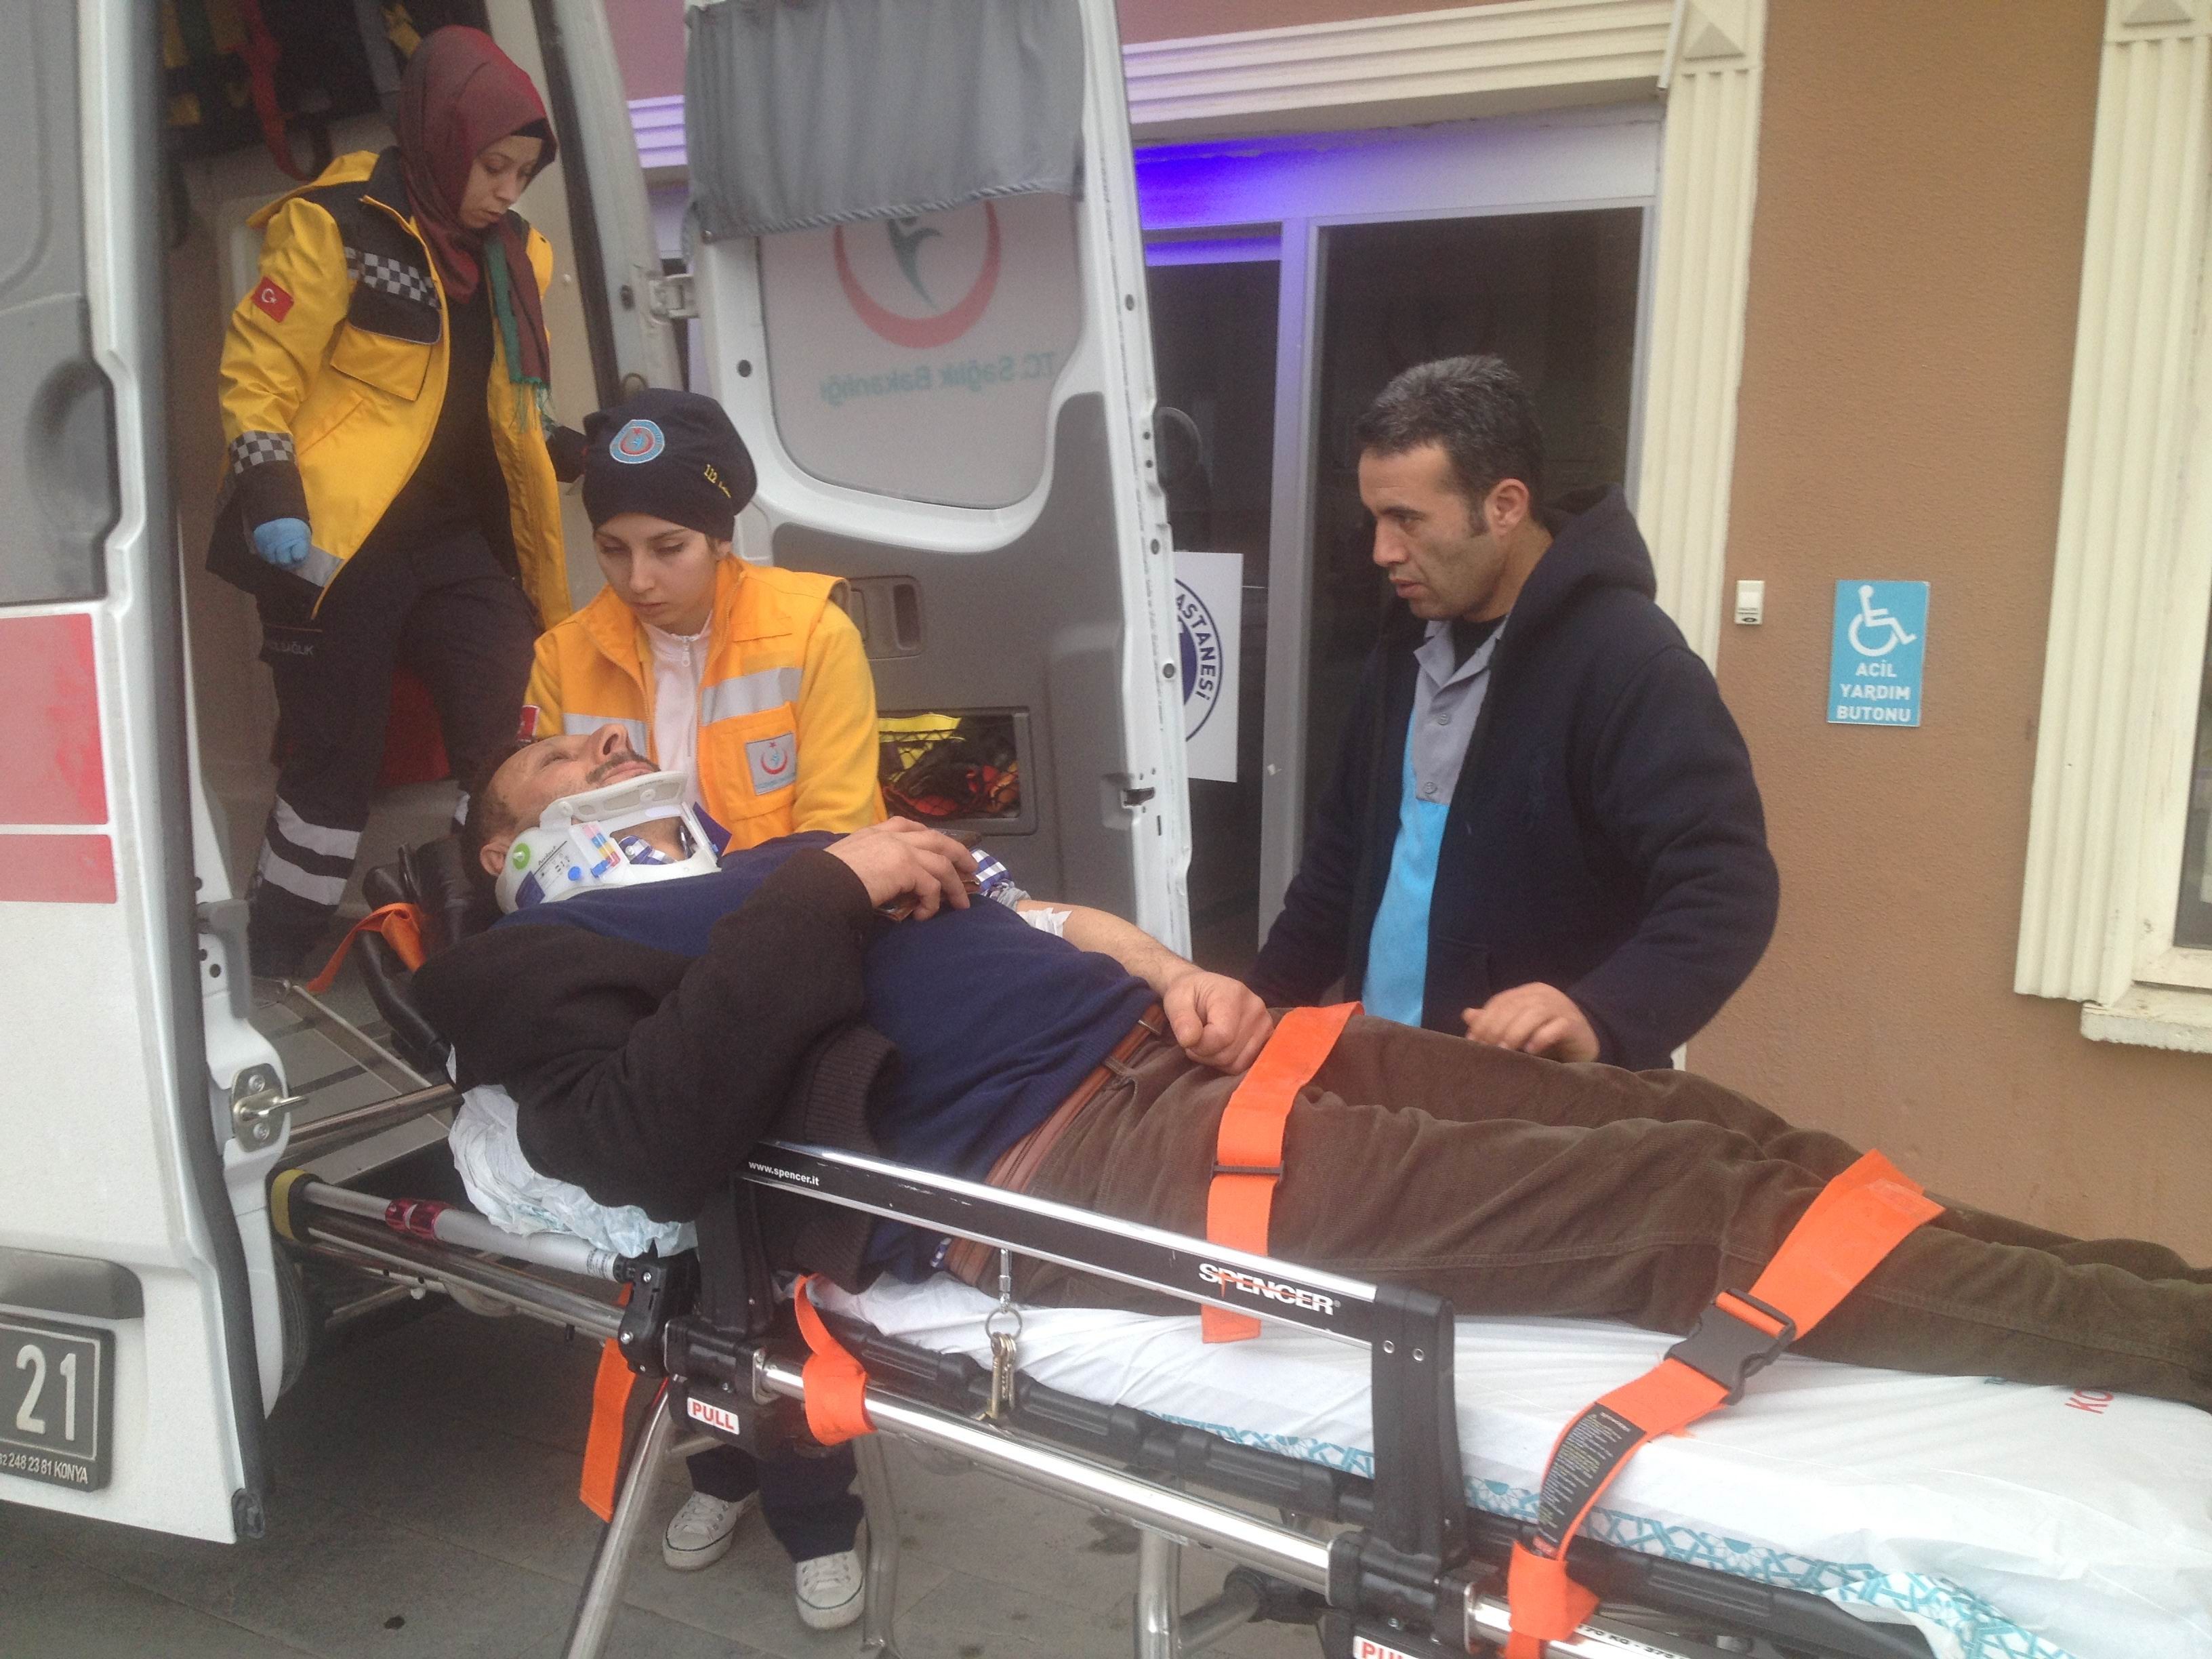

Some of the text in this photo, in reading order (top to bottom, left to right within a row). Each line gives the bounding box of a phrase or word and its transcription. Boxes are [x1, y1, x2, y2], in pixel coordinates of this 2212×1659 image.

[1176, 594, 1216, 701] ASTANESİ
[1856, 659, 1897, 678] ACİL
[1840, 683, 1910, 701] YARDIM
[1836, 705, 1911, 722] BUTONU
[749, 1161, 819, 1186] www.spencer.it
[1199, 1263, 1334, 1315] SPENCER
[16, 1344, 77, 1441] 21
[693, 1401, 735, 1431] PULL
[8, 1452, 27, 1470] 248
[28, 1456, 40, 1473] 23
[41, 1459, 52, 1475] 81
[54, 1460, 88, 1484] KONYA
